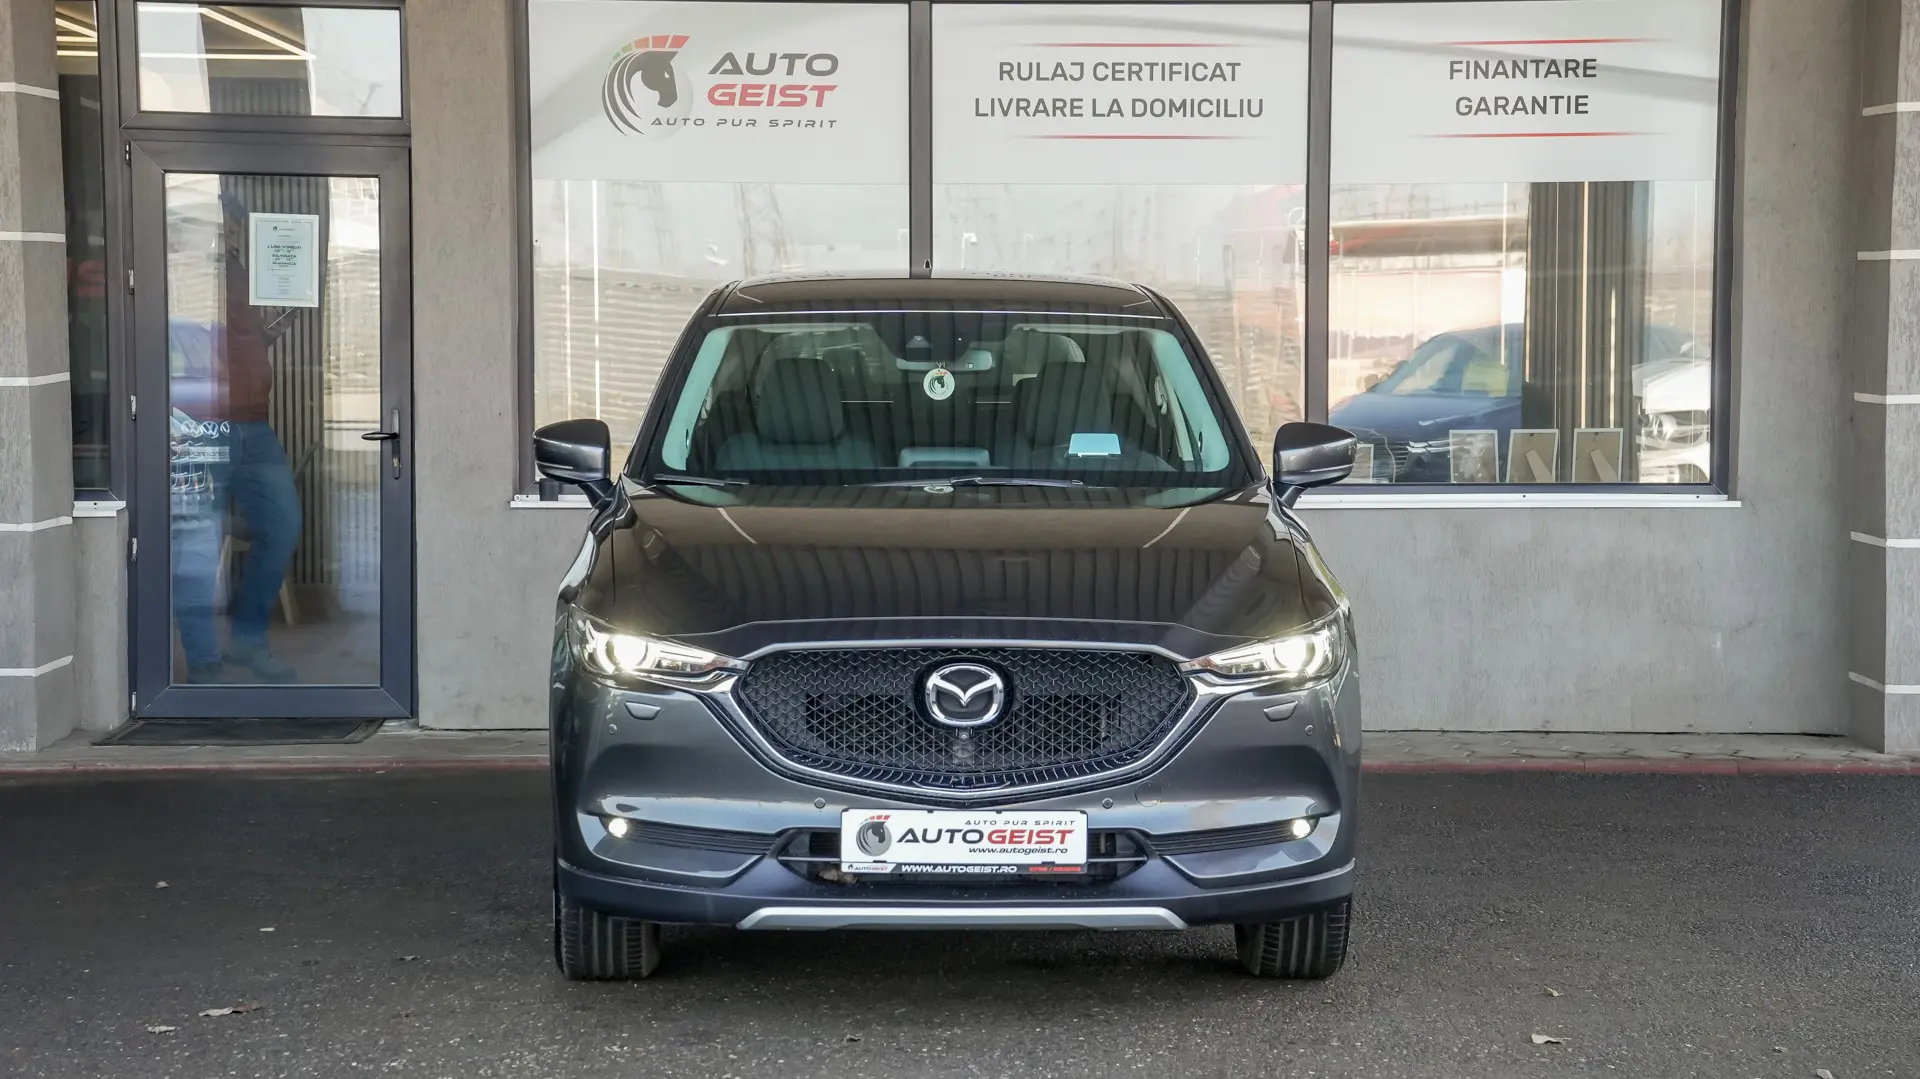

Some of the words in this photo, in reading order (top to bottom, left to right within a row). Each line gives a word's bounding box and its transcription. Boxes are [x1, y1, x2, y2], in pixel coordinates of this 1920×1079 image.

[707, 52, 839, 77] AUTO
[999, 61, 1085, 82] RULAJ
[1092, 62, 1241, 82] CERTIFICAT
[1449, 58, 1597, 80] FINANTARE
[707, 84, 839, 108] GEIST
[1455, 95, 1589, 116] GARANTIE
[975, 97, 1084, 118] LIVRARE
[1091, 98, 1125, 118] LA
[1131, 98, 1264, 118] DOMICILIU
[650, 117, 705, 127] AUTO
[716, 118, 757, 127] PUR
[768, 118, 838, 129] SPIRIT
[968, 846, 1069, 855] www.autogeist.ro
[901, 864, 1018, 873] WWW.AUTOGEIST.RO
